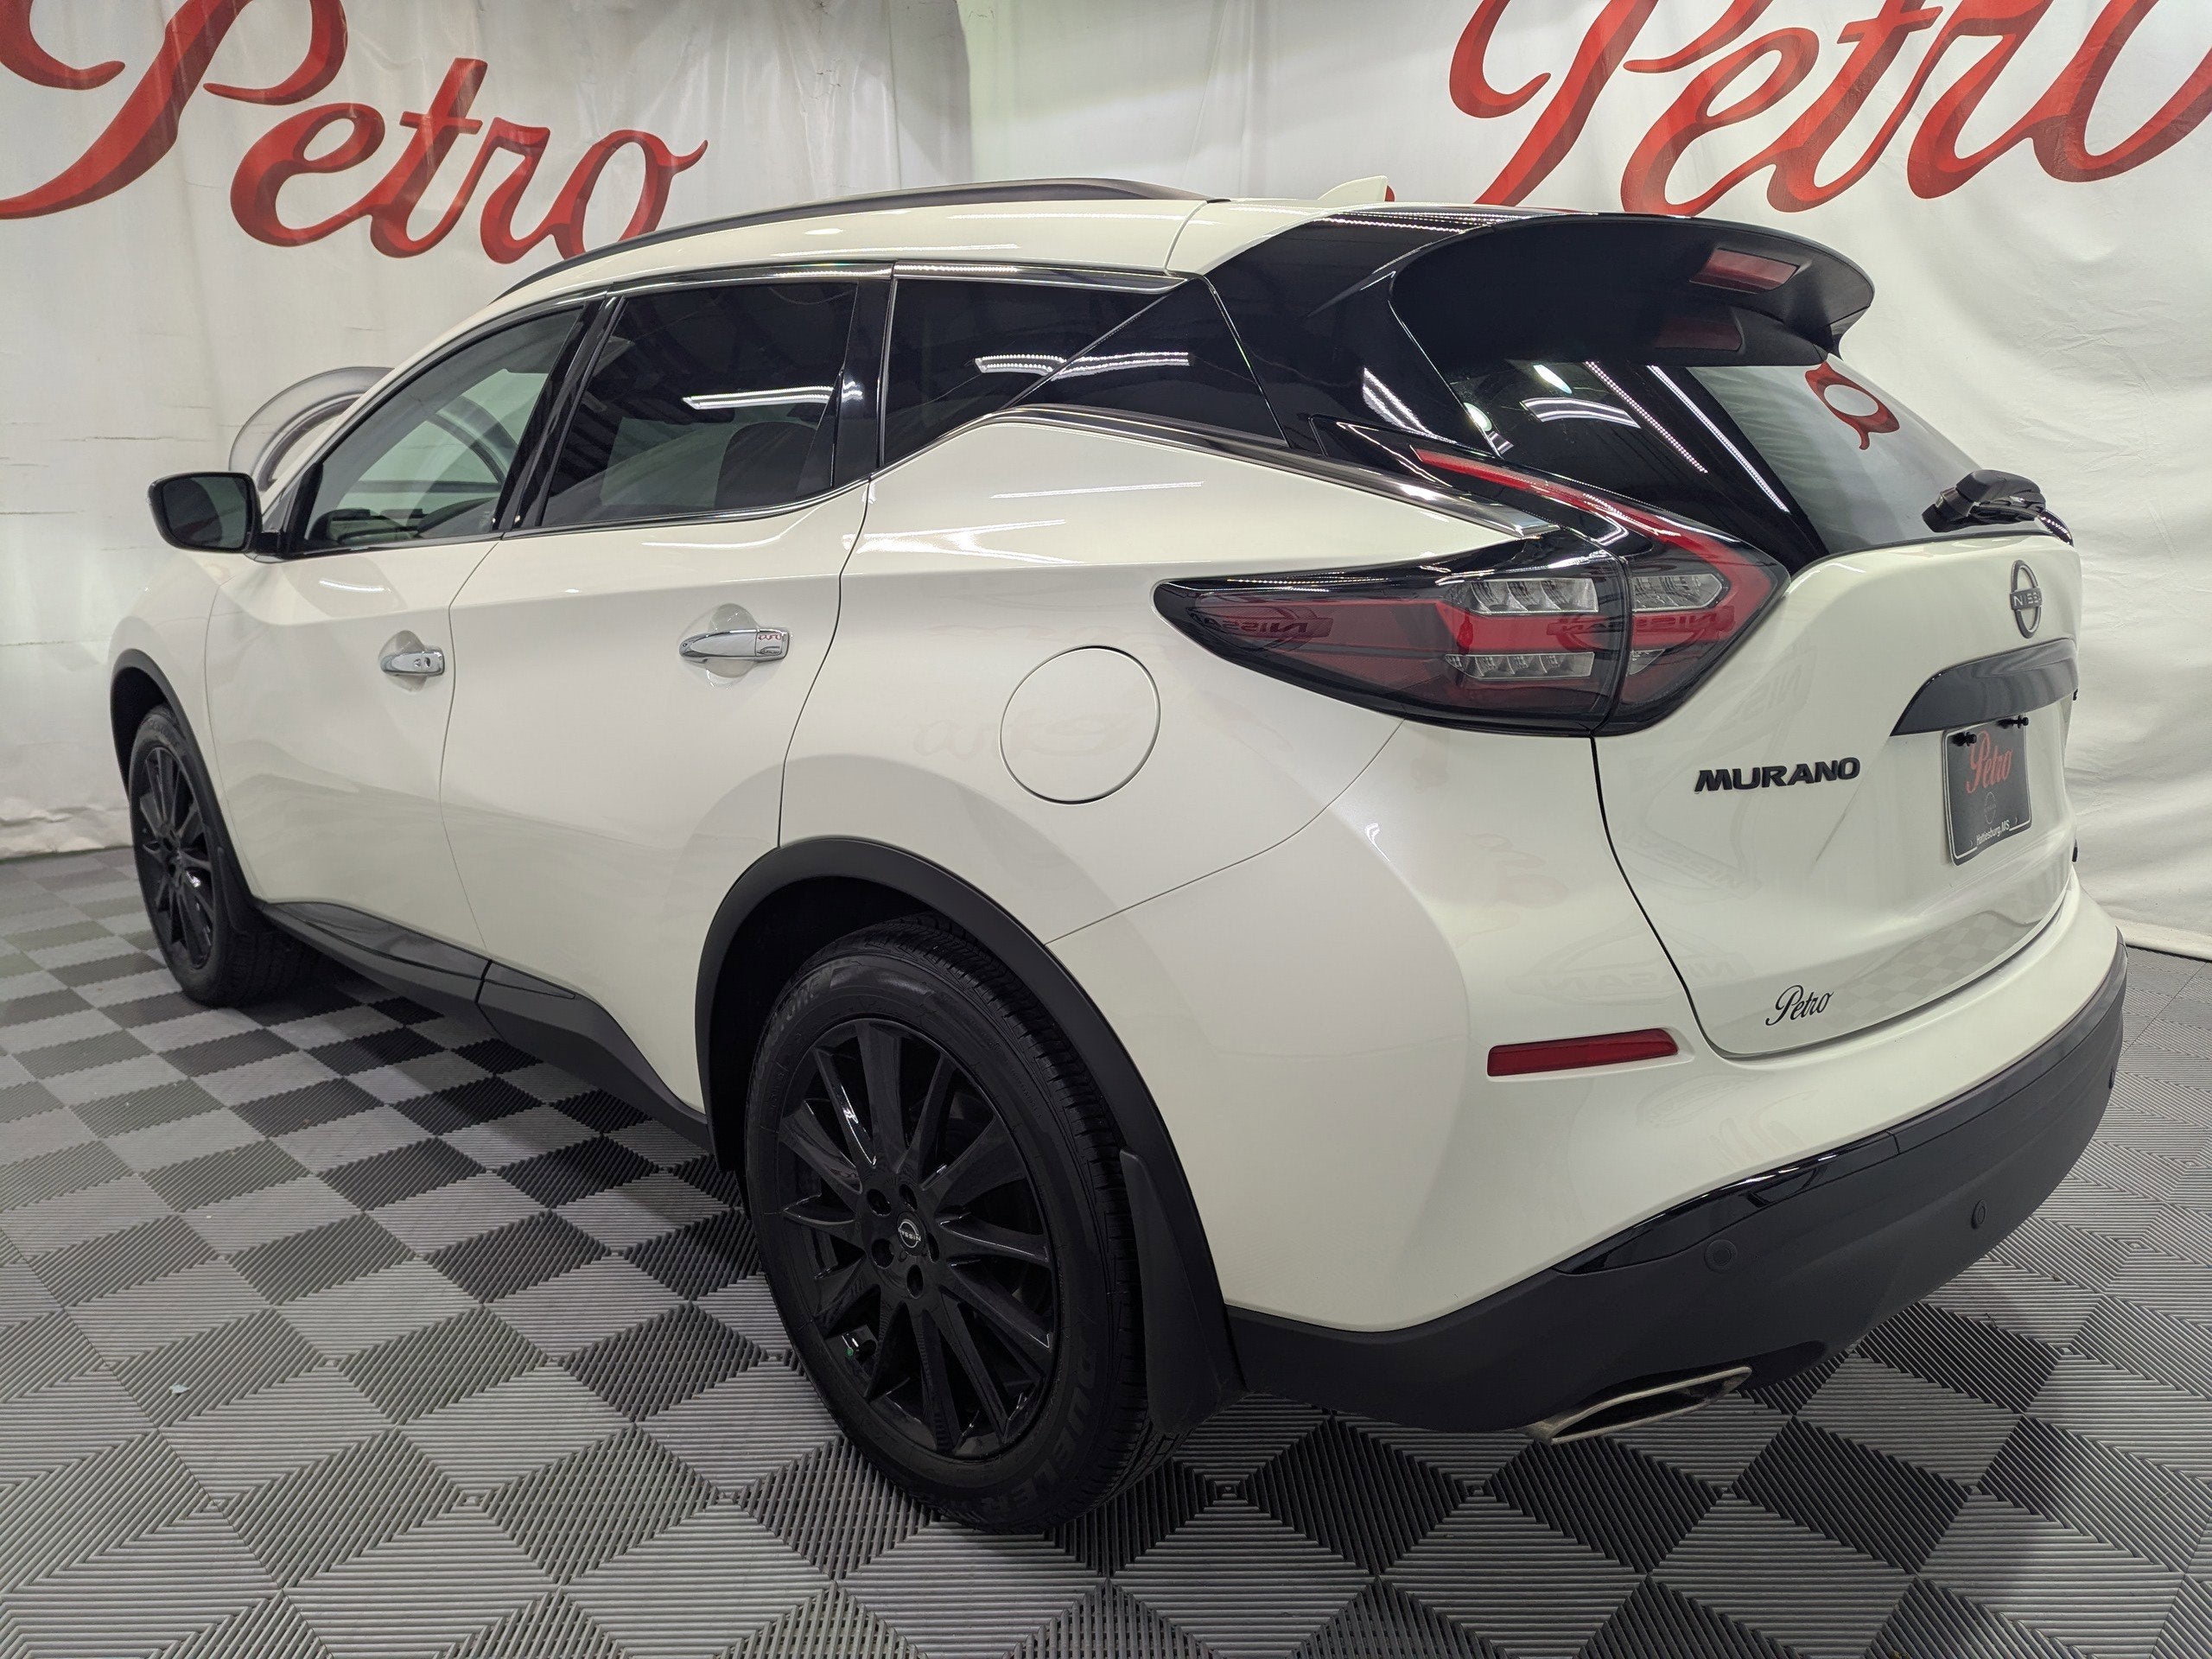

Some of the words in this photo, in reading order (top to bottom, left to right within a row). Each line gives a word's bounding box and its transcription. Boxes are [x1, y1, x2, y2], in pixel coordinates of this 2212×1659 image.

[0, 0, 708, 264] Petro
[1694, 757, 1860, 792] MURANO
[1966, 729, 2013, 794] Petro
[1765, 984, 1834, 1026] Petro
